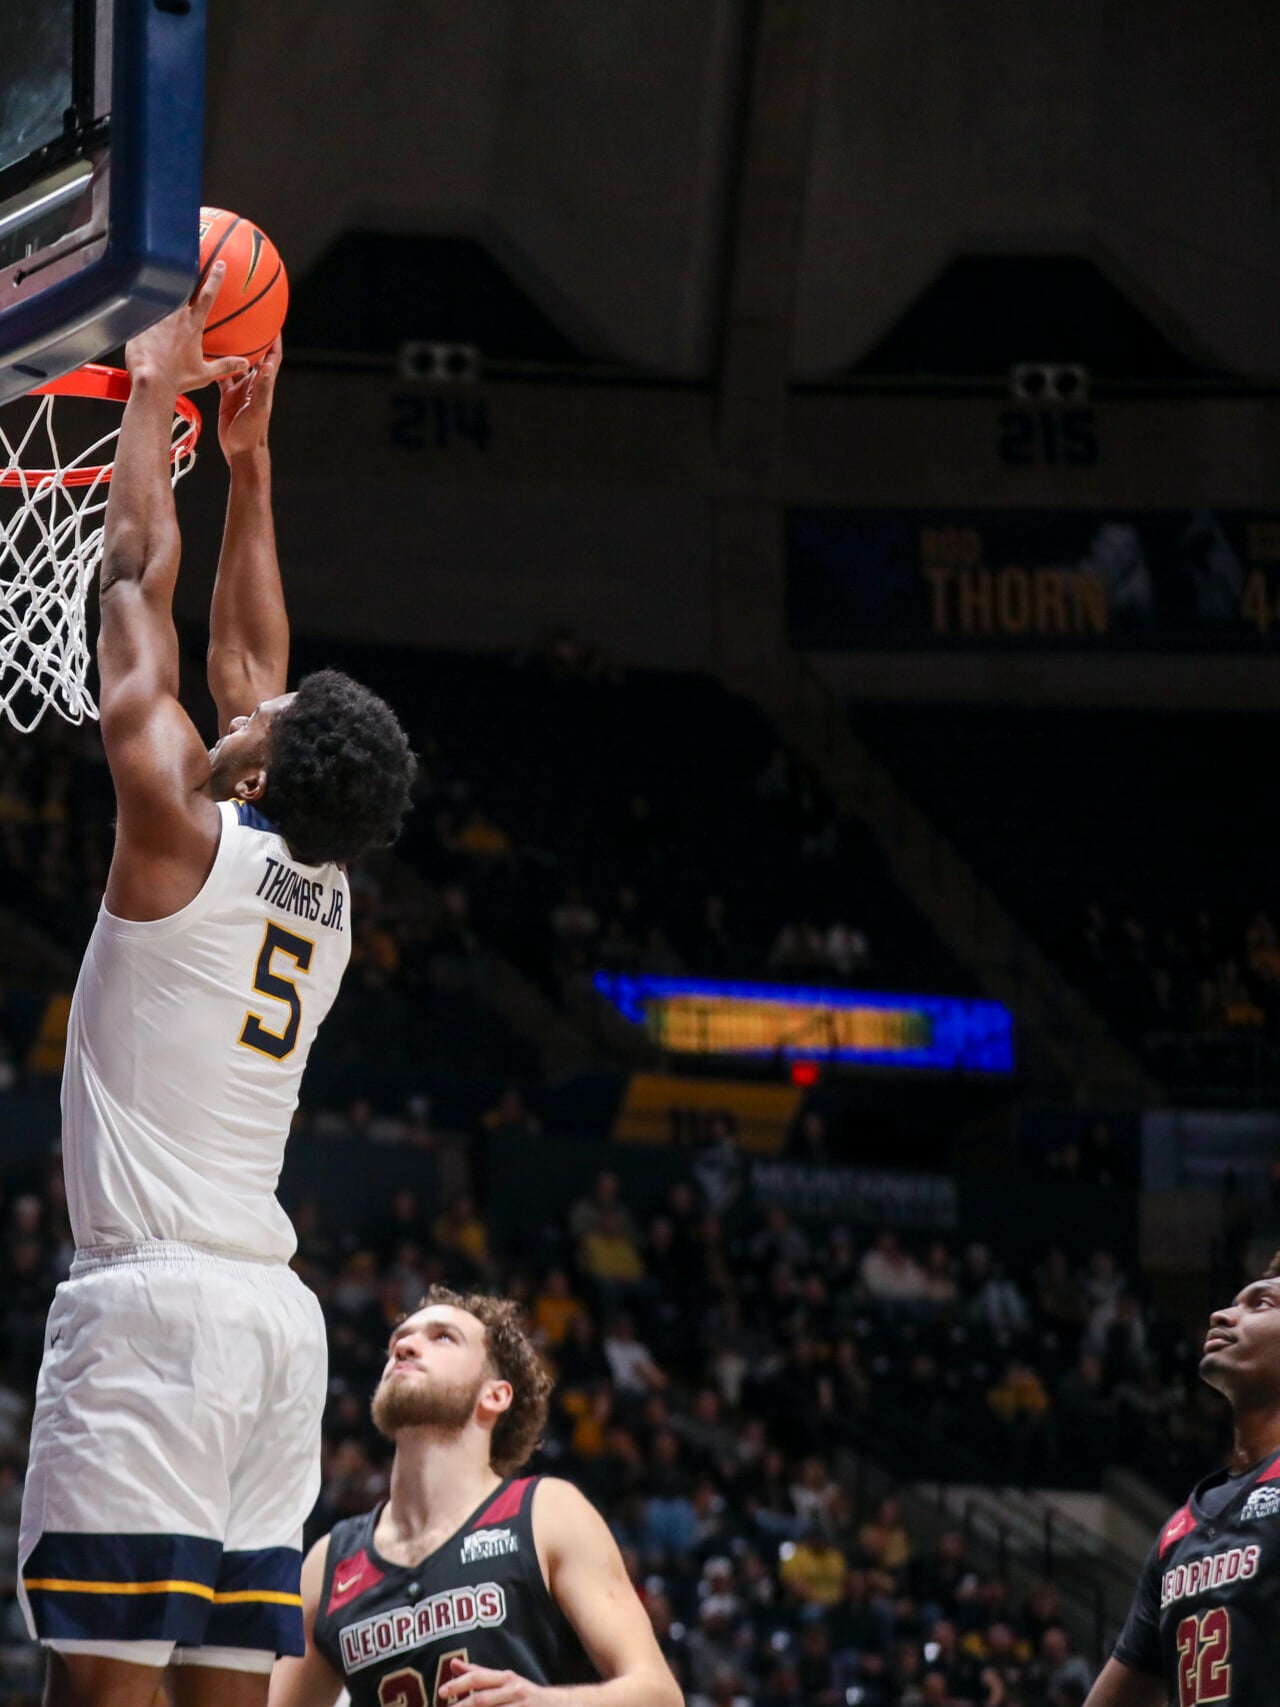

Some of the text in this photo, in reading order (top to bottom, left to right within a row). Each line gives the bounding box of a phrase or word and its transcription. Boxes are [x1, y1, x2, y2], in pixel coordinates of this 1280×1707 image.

[390, 395, 491, 450] 214
[997, 411, 1100, 465] 215
[923, 564, 1112, 637] THORN
[256, 857, 344, 931] THOMAS JR.
[237, 918, 316, 1062] 5
[1160, 1544, 1261, 1610] LEOPARDS
[339, 1581, 506, 1675] LEOPARDS
[1177, 1606, 1232, 1707] 22
